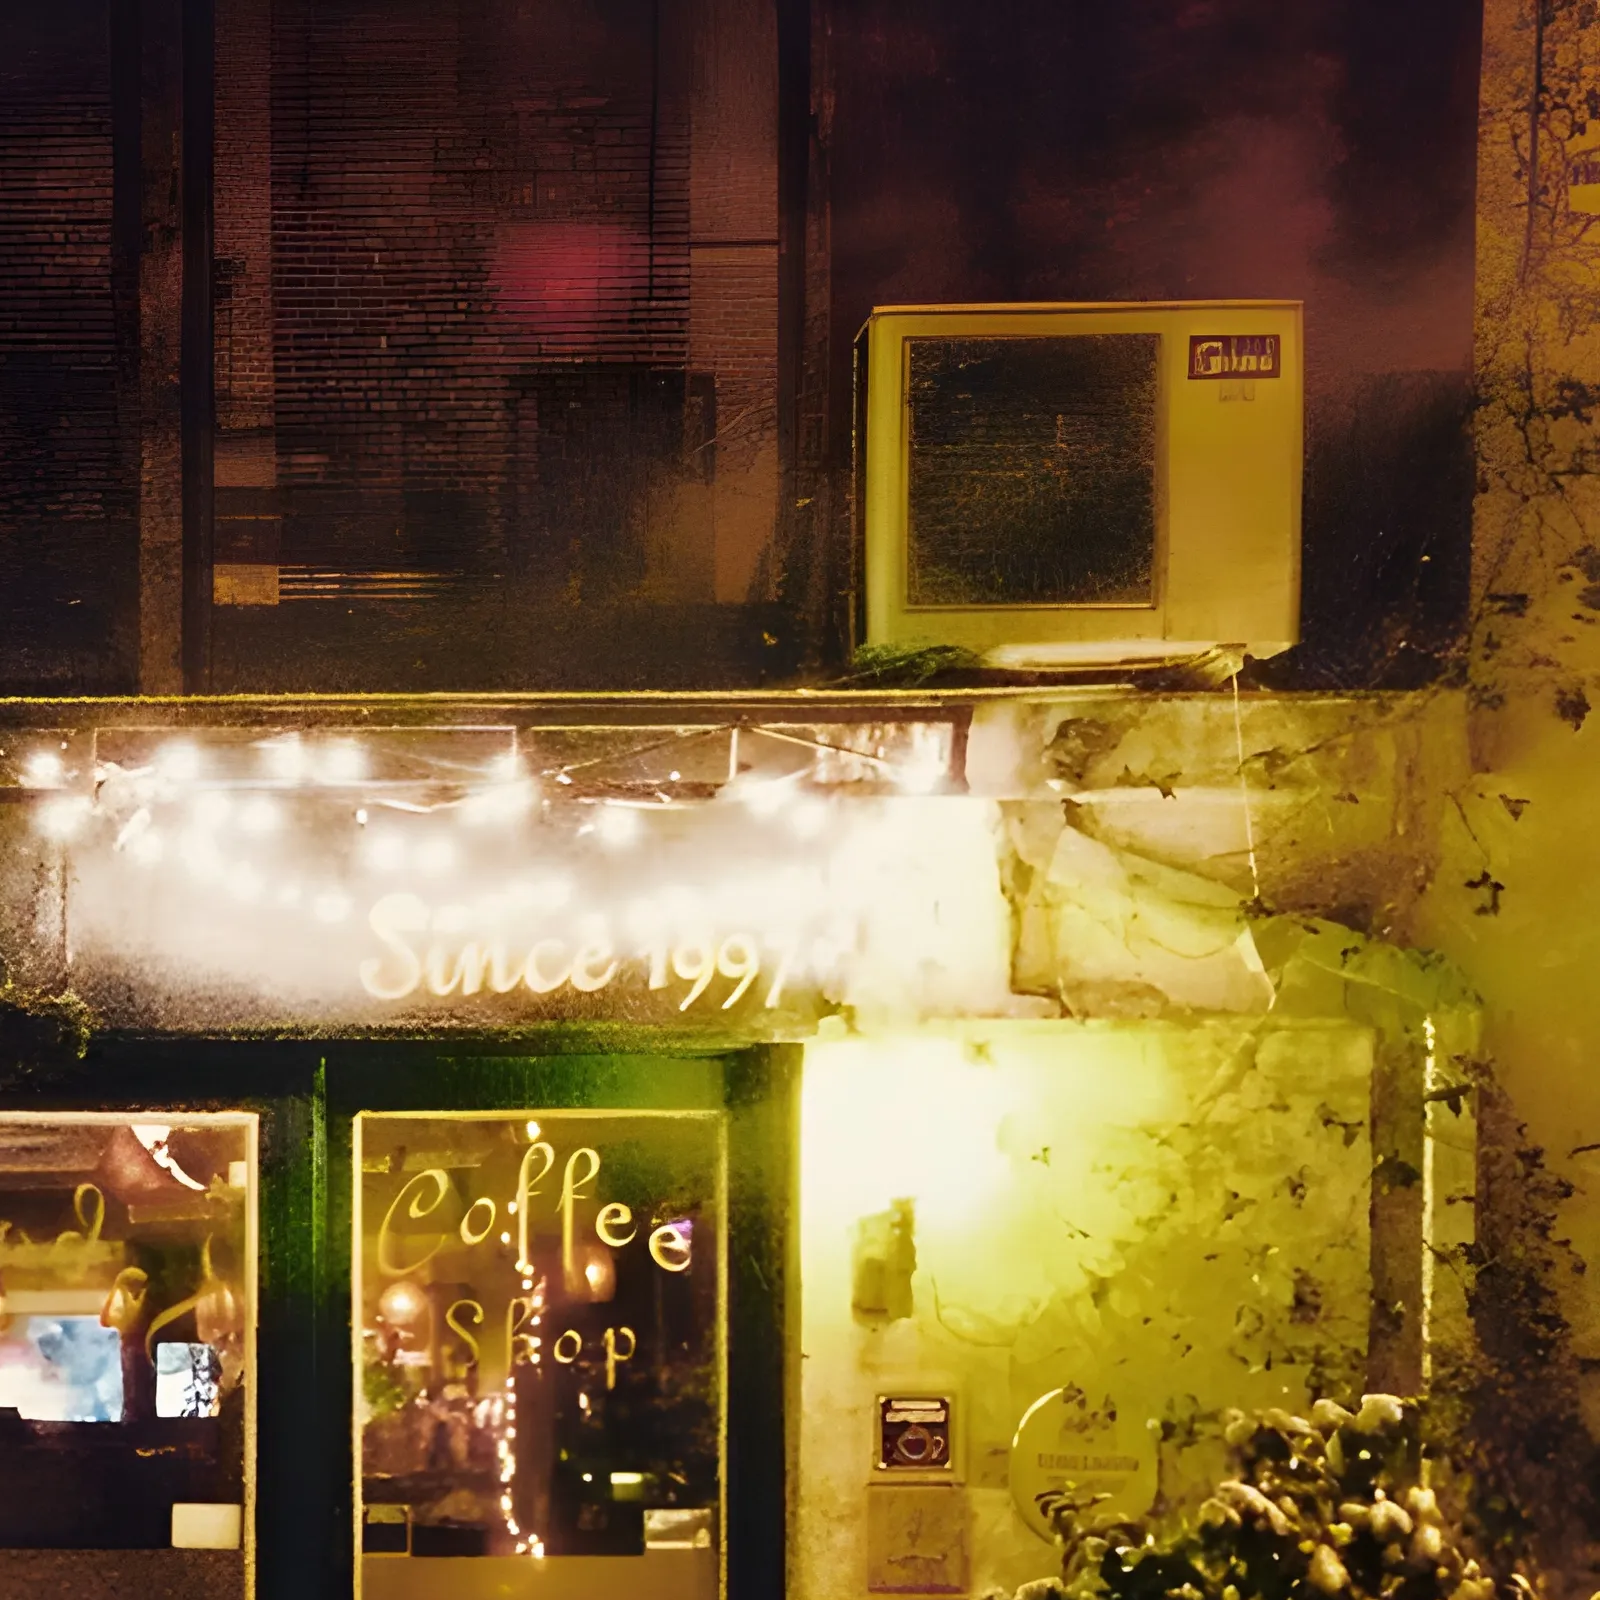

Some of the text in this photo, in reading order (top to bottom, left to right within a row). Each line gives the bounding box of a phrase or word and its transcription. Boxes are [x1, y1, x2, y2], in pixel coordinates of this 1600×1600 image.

[359, 893, 802, 1012] Since 1997
[377, 1141, 693, 1294] Coffee
[445, 1297, 637, 1390] Shop
